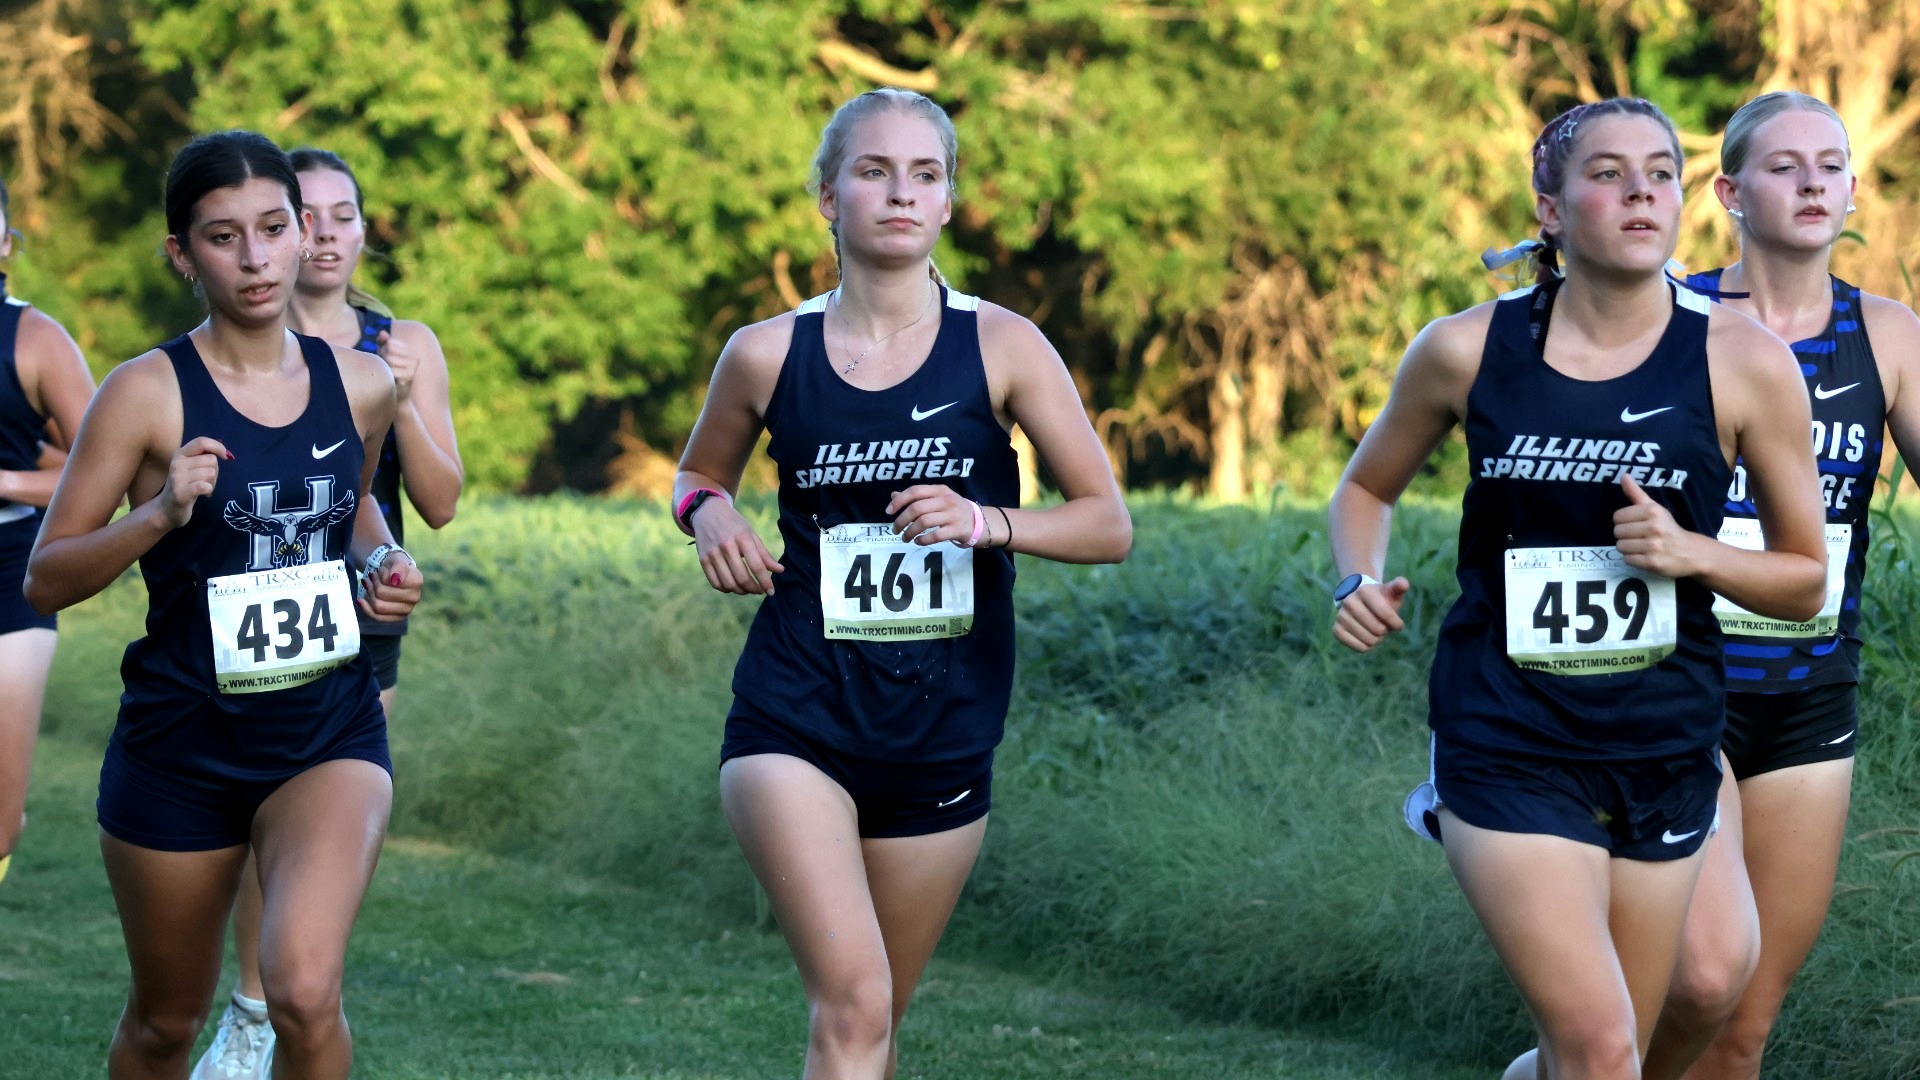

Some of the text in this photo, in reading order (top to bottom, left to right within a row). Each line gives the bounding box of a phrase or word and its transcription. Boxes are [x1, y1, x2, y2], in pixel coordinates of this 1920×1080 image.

[814, 437, 951, 466] ILLINOIS
[1505, 434, 1661, 463] ILLINOIS
[796, 458, 975, 489] SPRINGFIELD
[1480, 457, 1688, 490] SPRINGFIELD
[1552, 549, 1623, 562] TRXC
[249, 567, 310, 587] TRXC
[844, 551, 943, 613] 461
[1532, 577, 1650, 645] 459
[236, 593, 339, 663] 434
[836, 623, 946, 636] WWW.TRXCTIMING.COM
[229, 665, 335, 689] WWW.TRXCTIMING.COM
[1518, 655, 1645, 670] WWW.TRXCTIMING.COM
